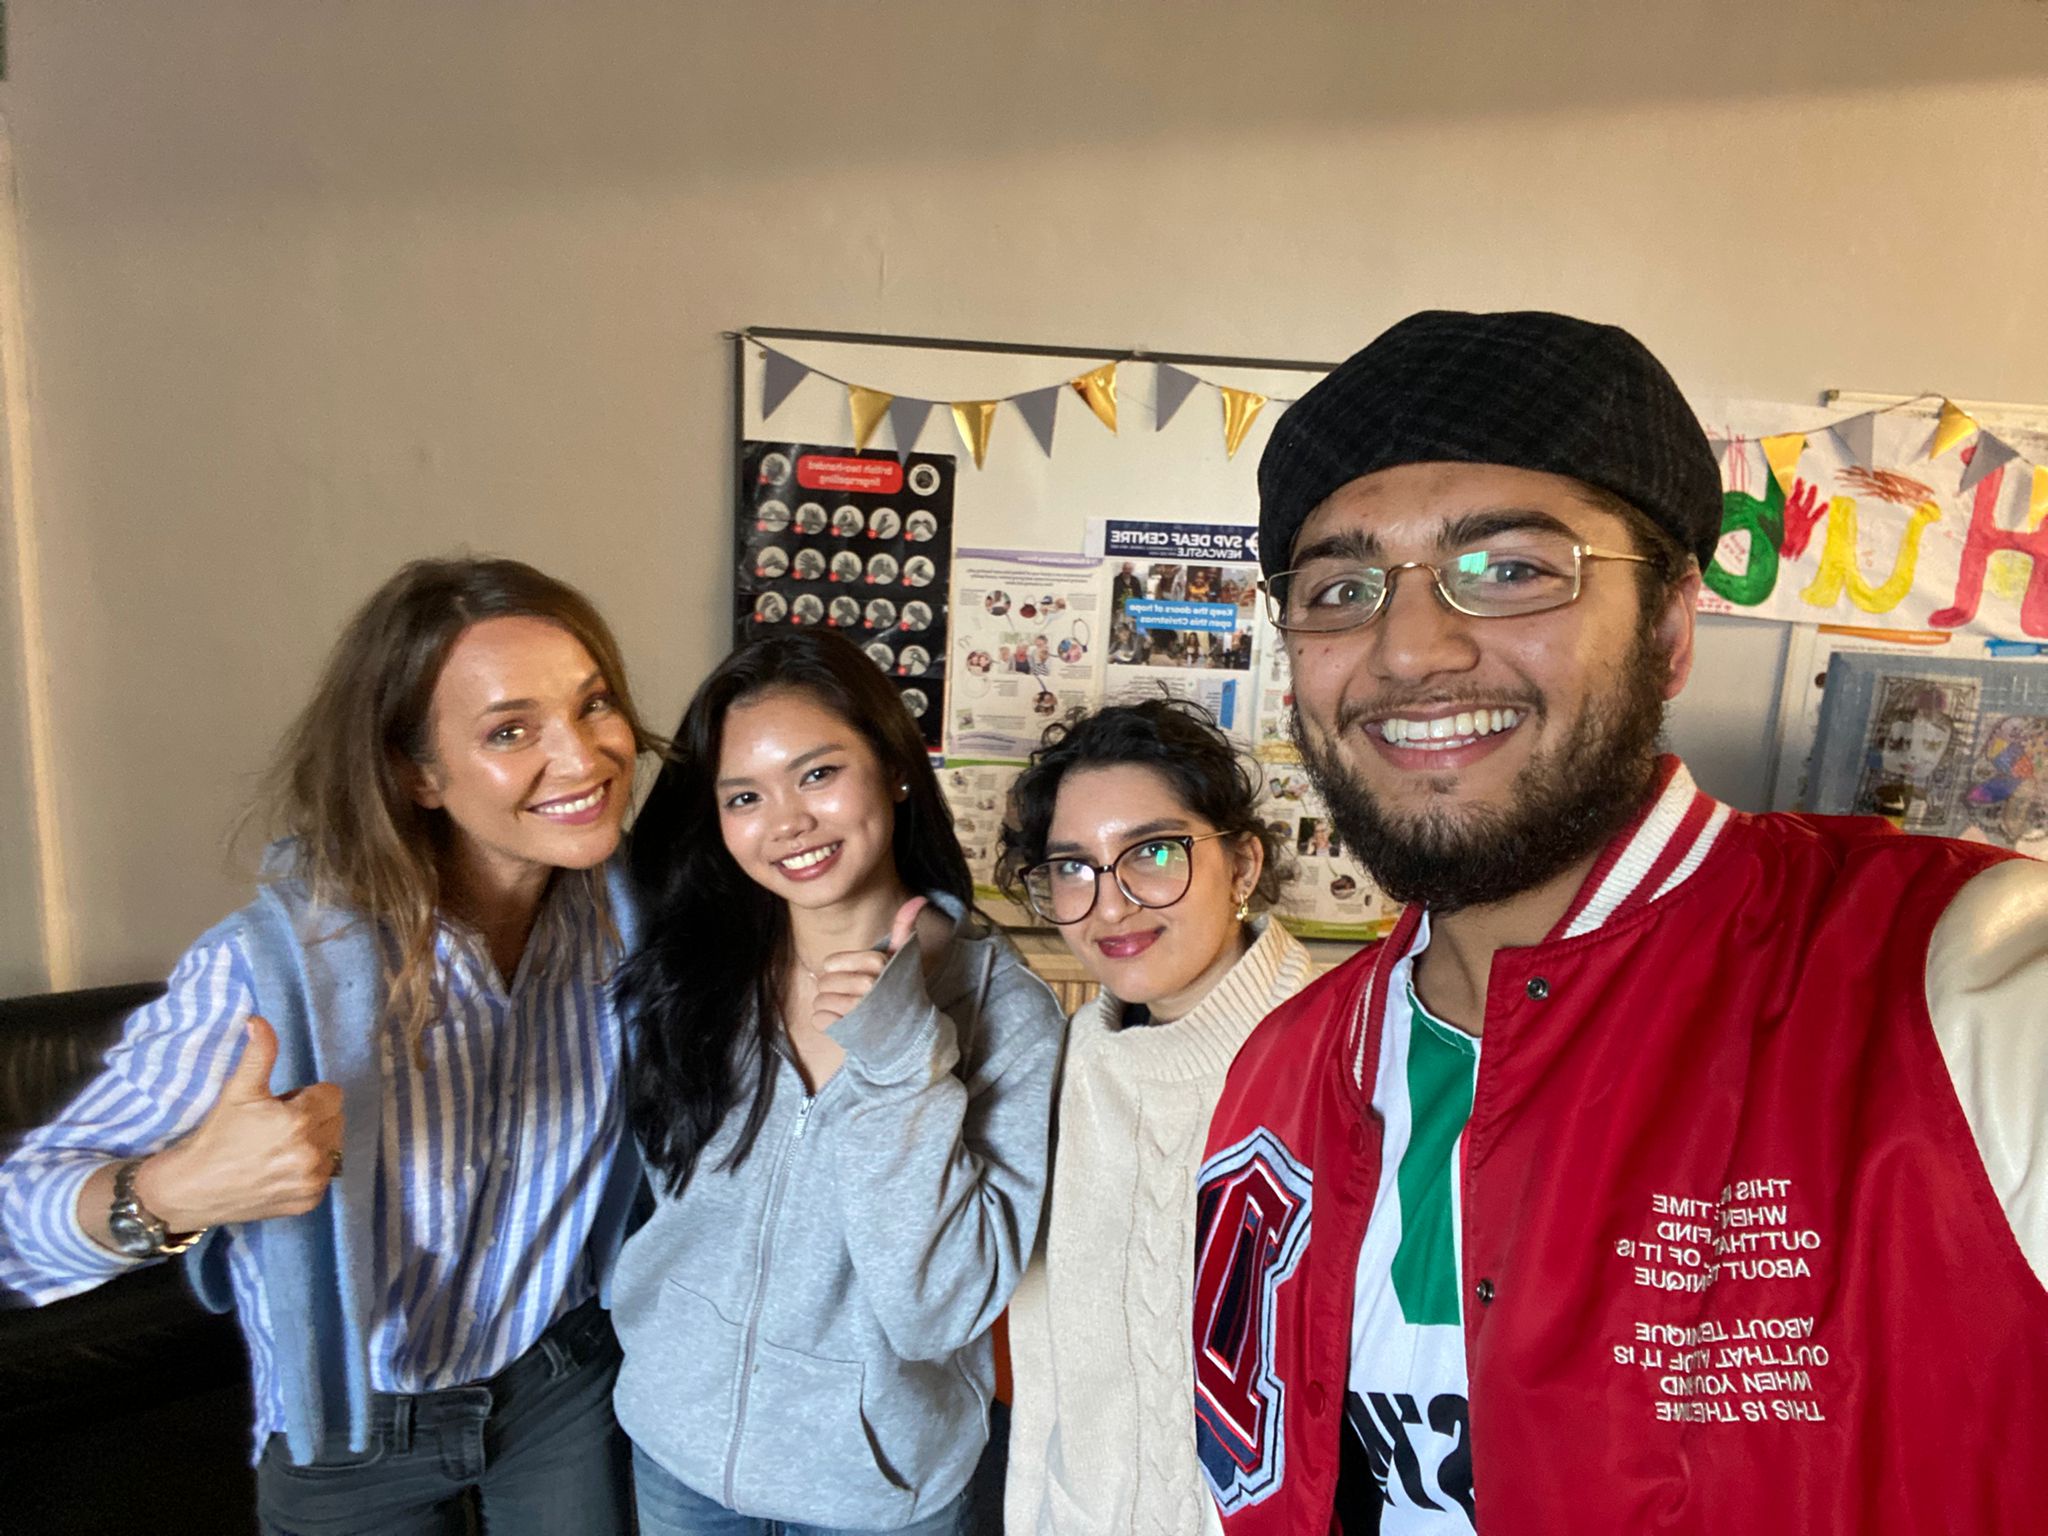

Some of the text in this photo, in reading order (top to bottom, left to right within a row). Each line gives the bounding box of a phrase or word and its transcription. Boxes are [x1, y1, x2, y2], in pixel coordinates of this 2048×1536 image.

[1733, 1316, 1814, 1341] ABOUT
[1613, 1345, 1635, 1365] IS
[1640, 1348, 1662, 1369] IT
[1715, 1345, 1780, 1368] THAT
[1781, 1344, 1829, 1367] OUT
[1697, 1373, 1737, 1395] YOU
[1742, 1370, 1813, 1393] WHEN
[1693, 1401, 1740, 1423] THE
[1741, 1400, 1768, 1421] IS
[1771, 1400, 1826, 1421] THIS
